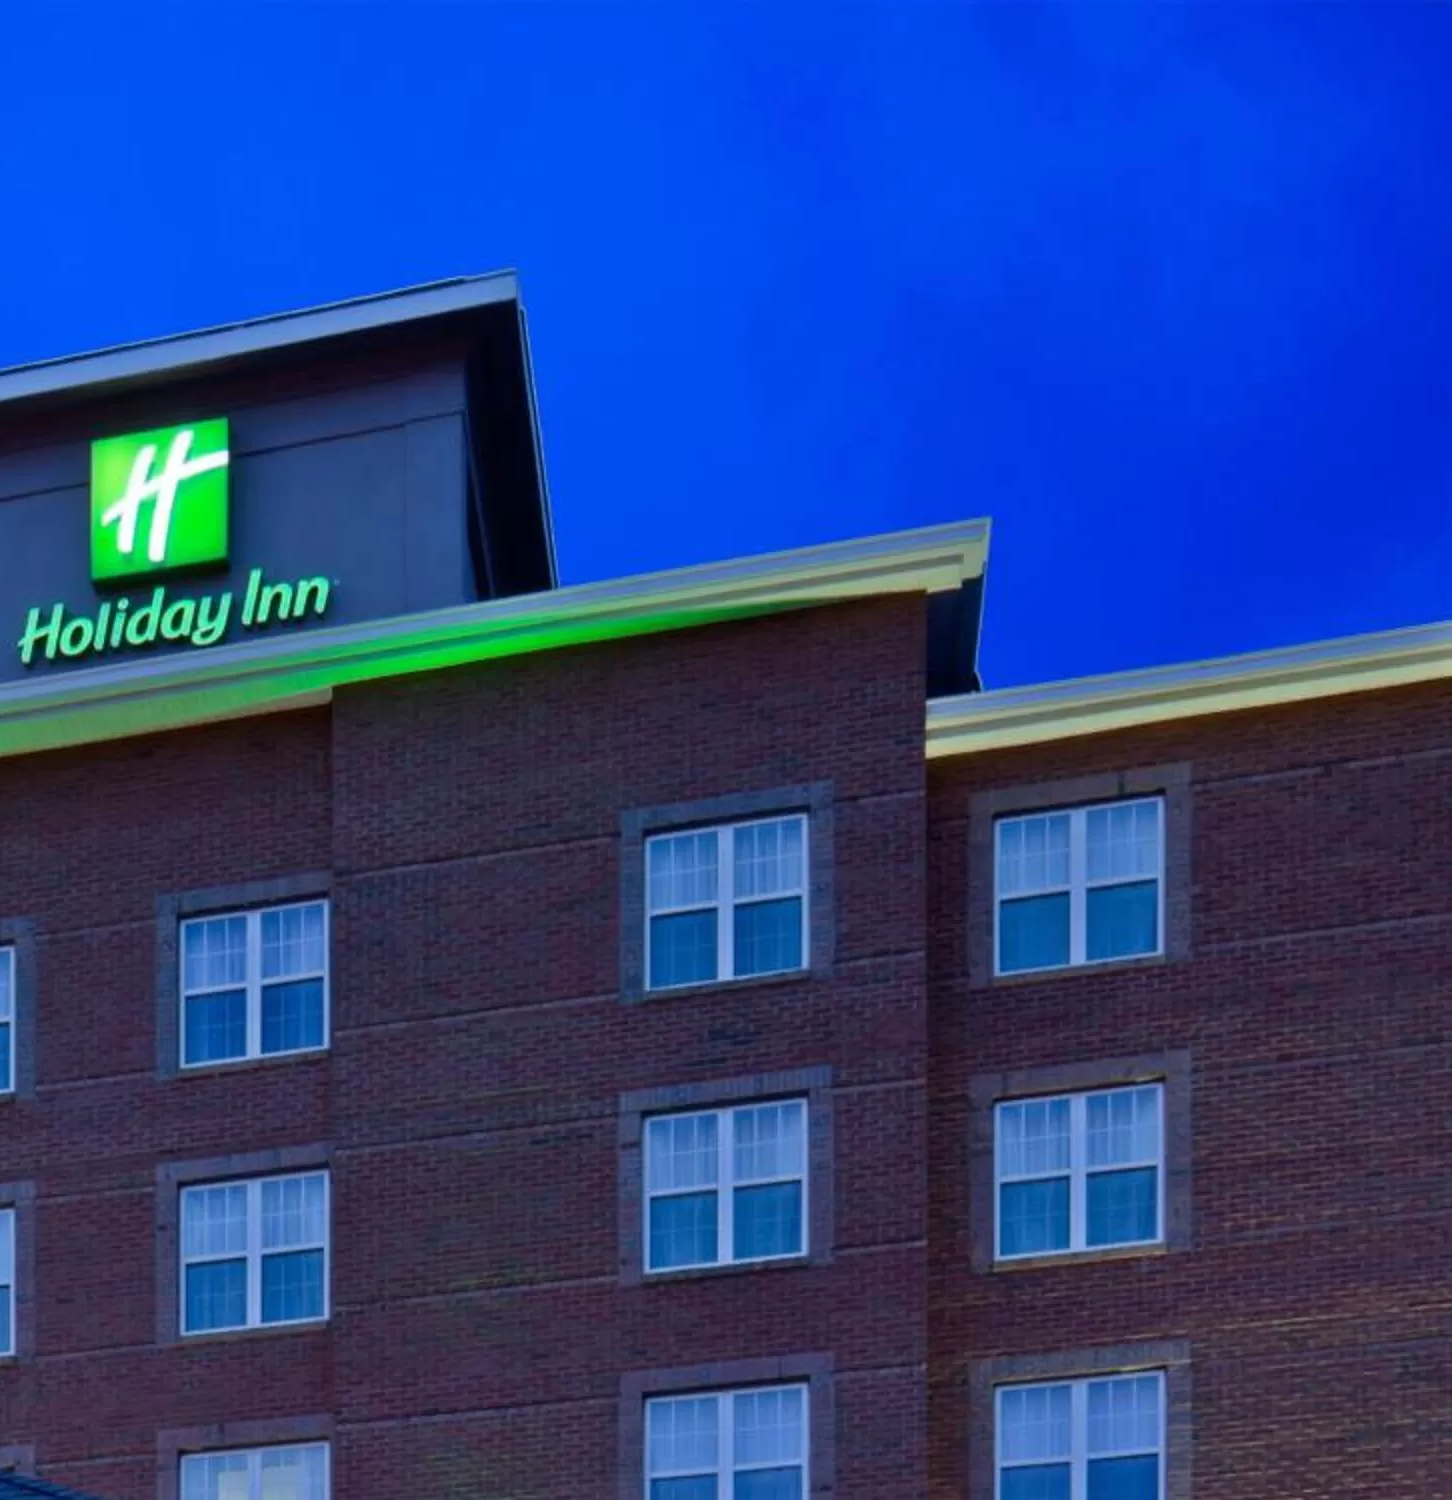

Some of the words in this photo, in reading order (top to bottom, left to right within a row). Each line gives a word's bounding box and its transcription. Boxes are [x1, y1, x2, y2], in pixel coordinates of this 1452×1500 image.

[101, 429, 229, 562] H
[18, 587, 232, 664] Holiday
[241, 568, 329, 626] Inn
